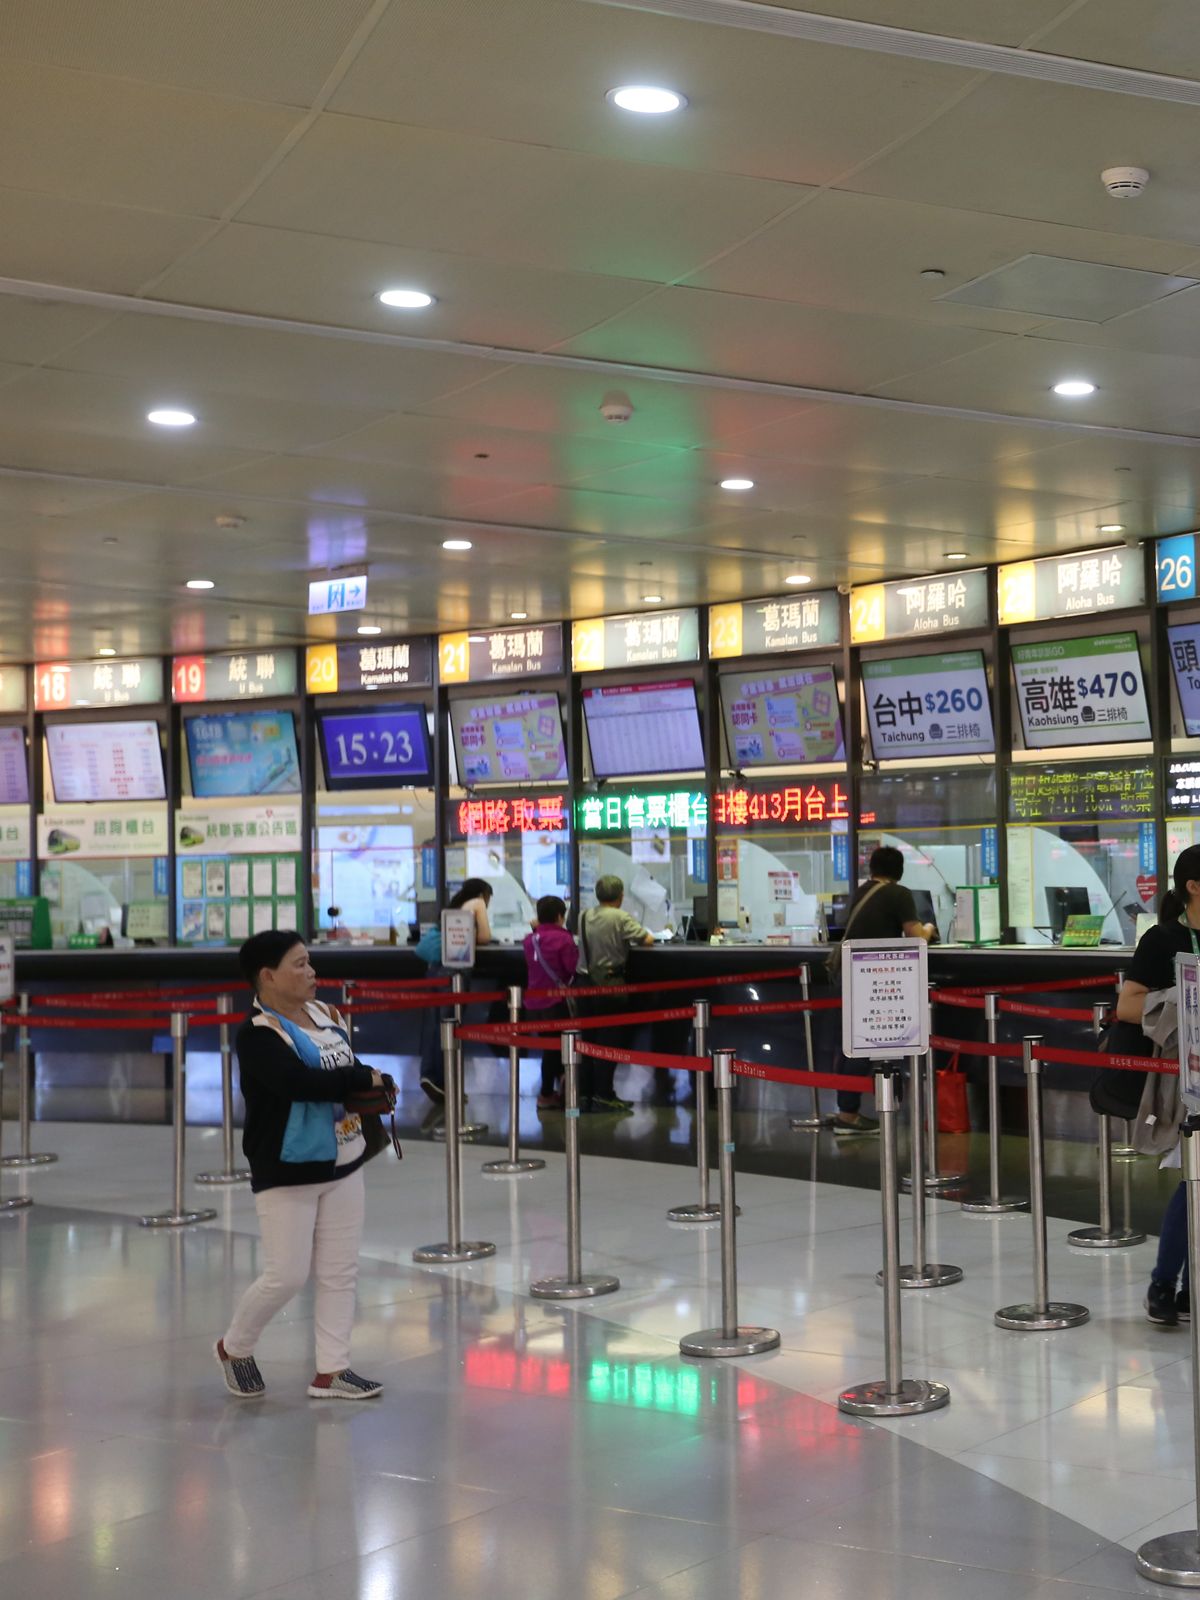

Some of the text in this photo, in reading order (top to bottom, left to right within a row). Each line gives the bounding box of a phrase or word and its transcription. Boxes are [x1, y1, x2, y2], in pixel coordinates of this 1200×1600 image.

[1058, 554, 1122, 594] 阿羅哈
[1160, 555, 1192, 591] 26
[905, 578, 966, 615] 阿羅哈
[1066, 593, 1114, 610] Aloha Bus
[763, 599, 819, 632] 葛瑪蘭
[855, 598, 881, 632] 24
[913, 614, 959, 631] Aloha Bus
[714, 617, 738, 648] 23
[802, 631, 817, 643] Bus
[309, 657, 335, 683] 20
[443, 643, 466, 673] 21
[40, 672, 65, 701] 18
[177, 664, 201, 694] 19
[1077, 671, 1138, 699] $470
[873, 690, 923, 728] 台中
[924, 687, 983, 714] $260
[1021, 675, 1078, 715] 高雄
[1028, 713, 1079, 727] Kaohsiung
[1096, 706, 1128, 722] 三排椅
[881, 730, 925, 743] Taichung
[945, 723, 980, 740] 三排椅
[336, 730, 413, 765] 15:23
[458, 796, 563, 834] 網路取票
[582, 792, 707, 830] 當日售票櫃台
[733, 1061, 766, 1077] Bus Station
